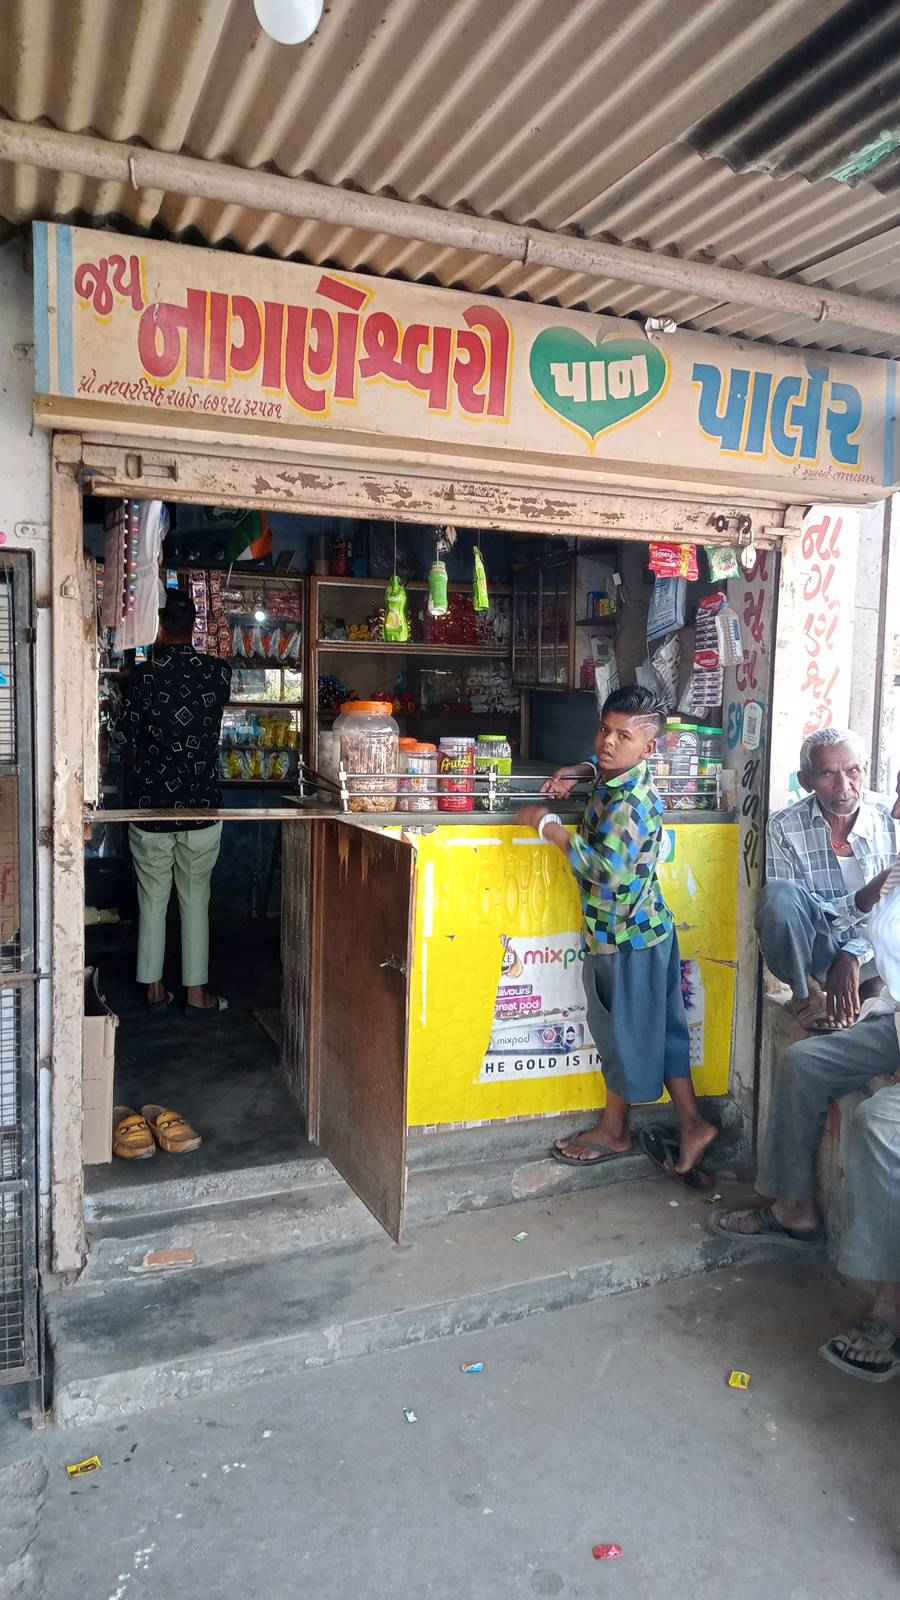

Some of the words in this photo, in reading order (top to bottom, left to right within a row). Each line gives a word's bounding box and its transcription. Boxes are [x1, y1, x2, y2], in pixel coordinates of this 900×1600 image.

[74, 254, 145, 316] જય
[550, 355, 650, 402] પાન
[691, 364, 863, 465] પાર્લર
[524, 946, 588, 970] mixpo
[497, 986, 530, 997] avours
[497, 1032, 530, 1046] mixpod
[485, 1061, 505, 1074] HE
[514, 1057, 557, 1071] GOLD
[566, 1055, 580, 1067] IS
